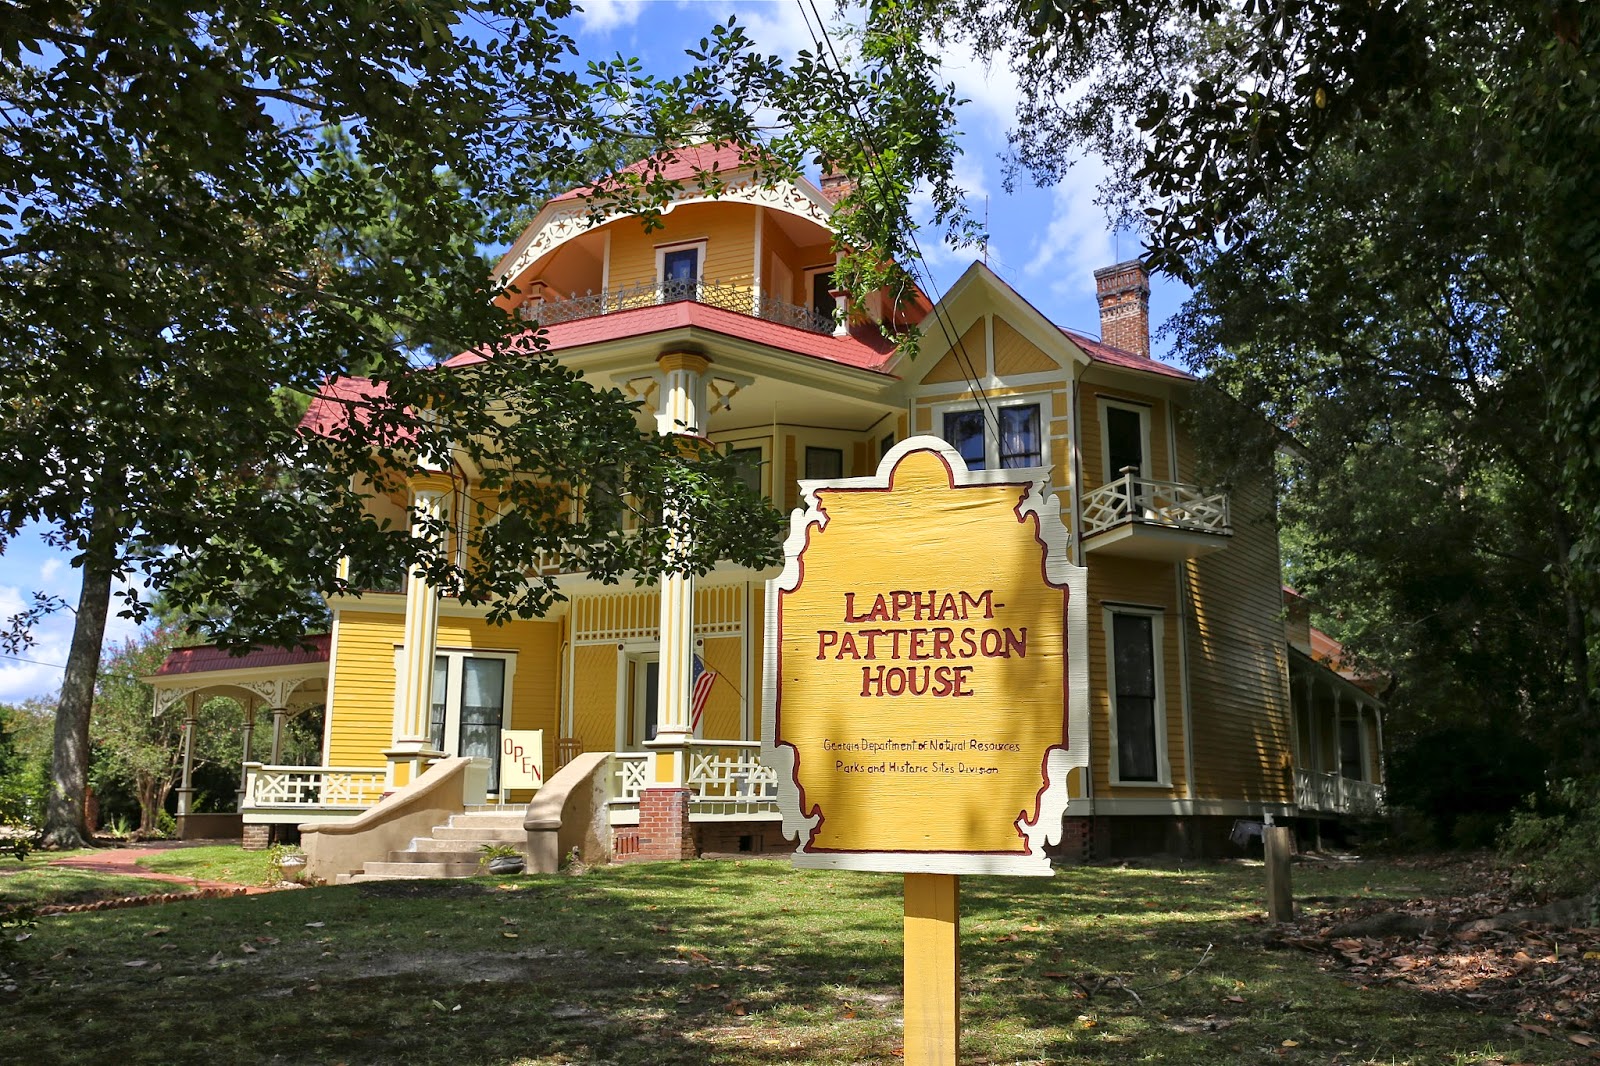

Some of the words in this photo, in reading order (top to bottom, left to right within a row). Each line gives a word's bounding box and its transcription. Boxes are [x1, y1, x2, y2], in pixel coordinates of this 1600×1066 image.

[844, 590, 1005, 623] LAPHAM-
[816, 627, 1028, 660] PATTERSON
[860, 665, 974, 697] HOUSE
[504, 738, 541, 781] OPEN
[823, 739, 860, 752] Georgia
[861, 738, 918, 754] Department
[918, 740, 928, 751] of
[929, 739, 966, 751] Natural
[969, 739, 1021, 752] Resources
[836, 760, 865, 773] Parks
[867, 762, 886, 774] and
[889, 760, 929, 774] Historic
[932, 761, 955, 774] Sites
[958, 762, 999, 775] Division
